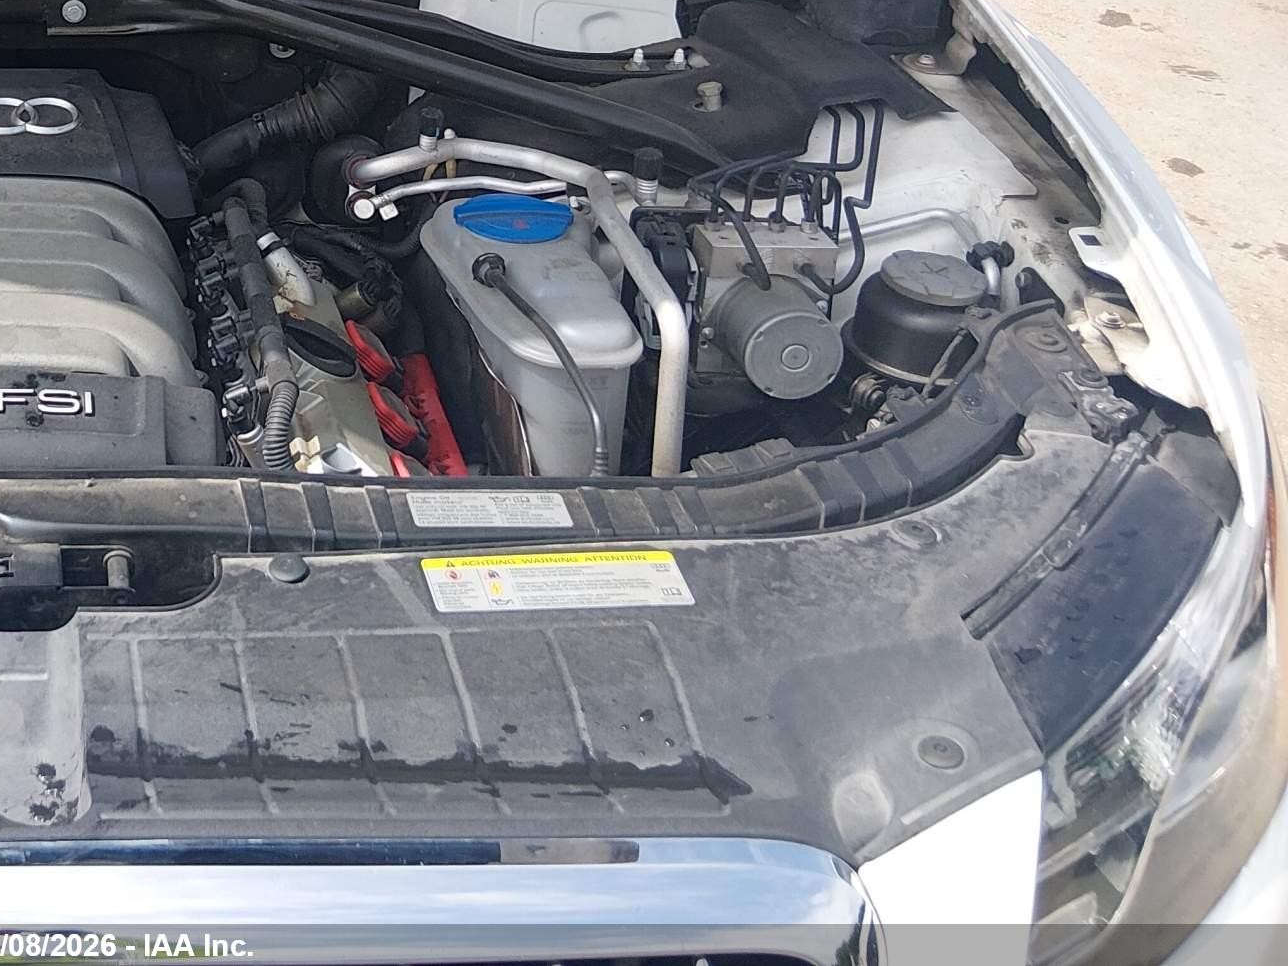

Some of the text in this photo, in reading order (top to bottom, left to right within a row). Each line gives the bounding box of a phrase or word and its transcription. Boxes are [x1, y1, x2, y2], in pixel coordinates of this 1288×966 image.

[461, 554, 647, 567] ACHTUNG WARNING ATTENTION
